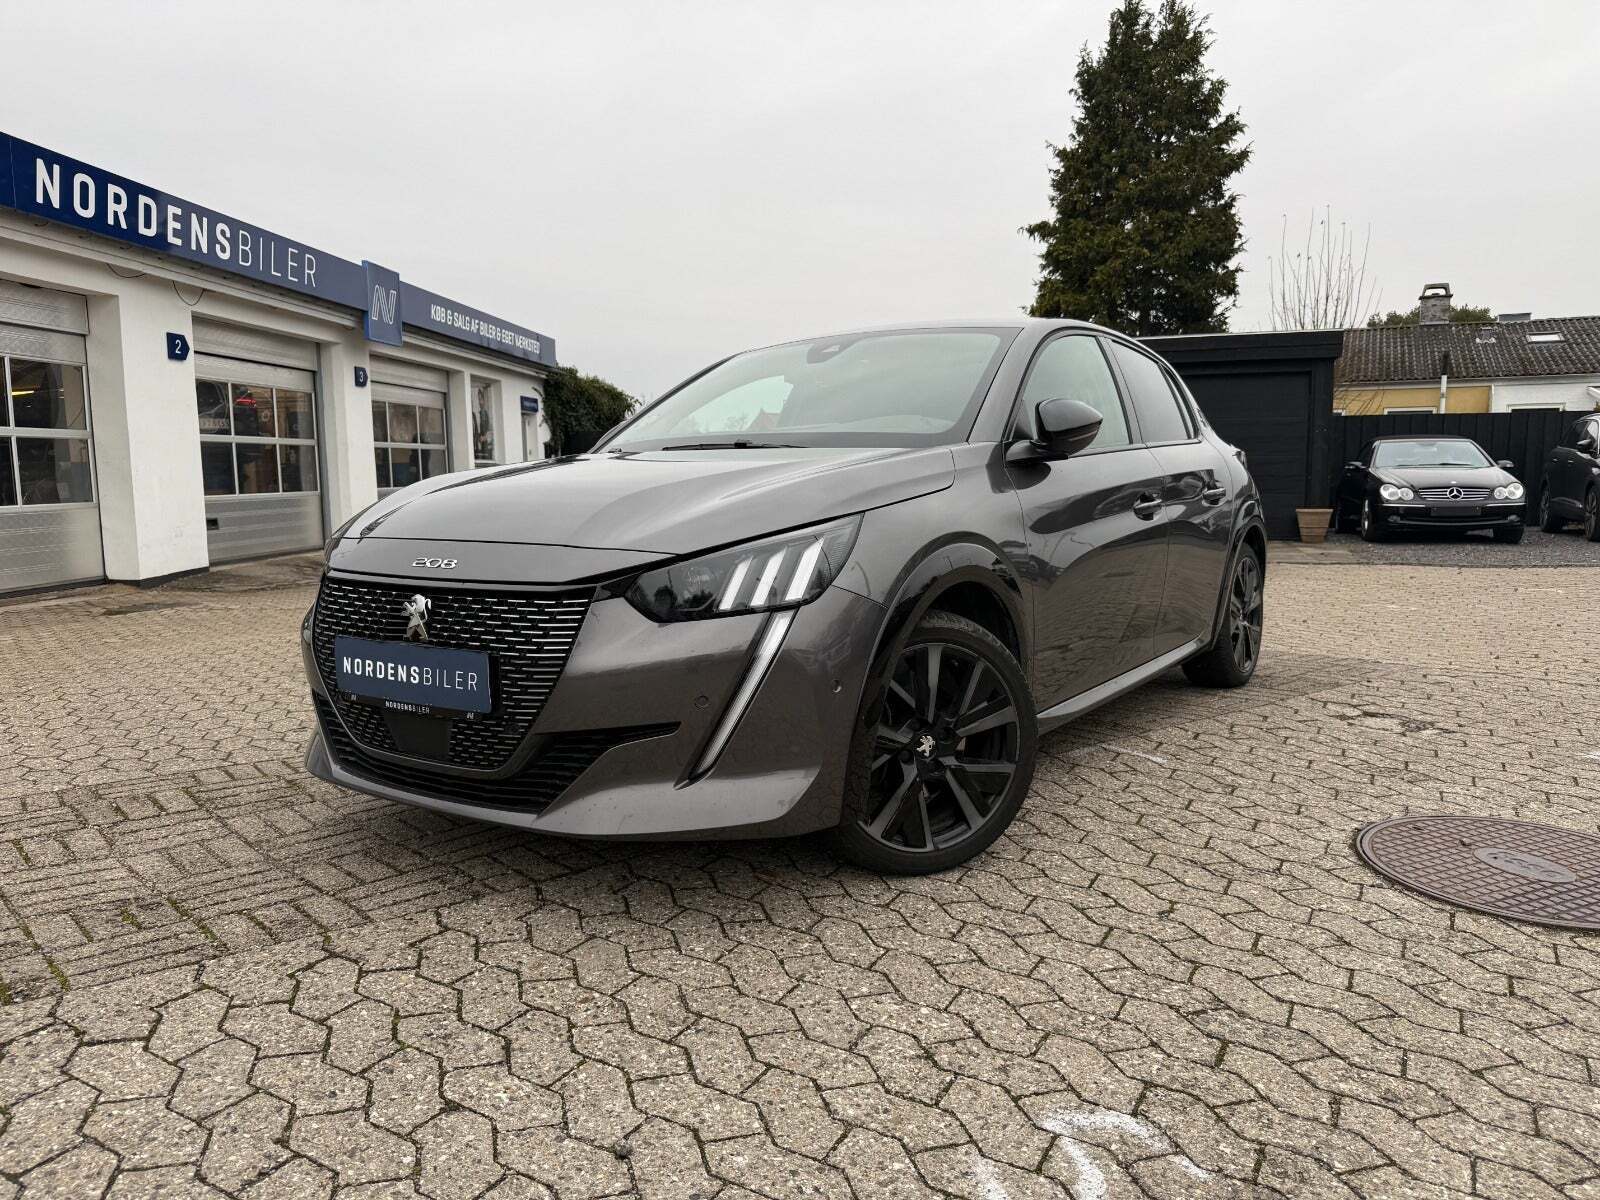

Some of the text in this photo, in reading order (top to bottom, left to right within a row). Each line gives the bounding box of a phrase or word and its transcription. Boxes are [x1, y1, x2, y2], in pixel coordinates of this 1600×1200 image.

[36, 158, 316, 287] NORDENSBILER
[431, 304, 446, 323] KØB
[447, 311, 453, 325] &
[453, 313, 470, 330] SALG
[470, 318, 479, 333] AF
[480, 322, 496, 339] BILER
[501, 329, 515, 346] EGET
[175, 340, 182, 354] 2
[359, 371, 364, 383] 3
[412, 557, 458, 569] 208
[343, 656, 478, 692] NORDENSBILER
[385, 700, 430, 714] NORDENSBILER
